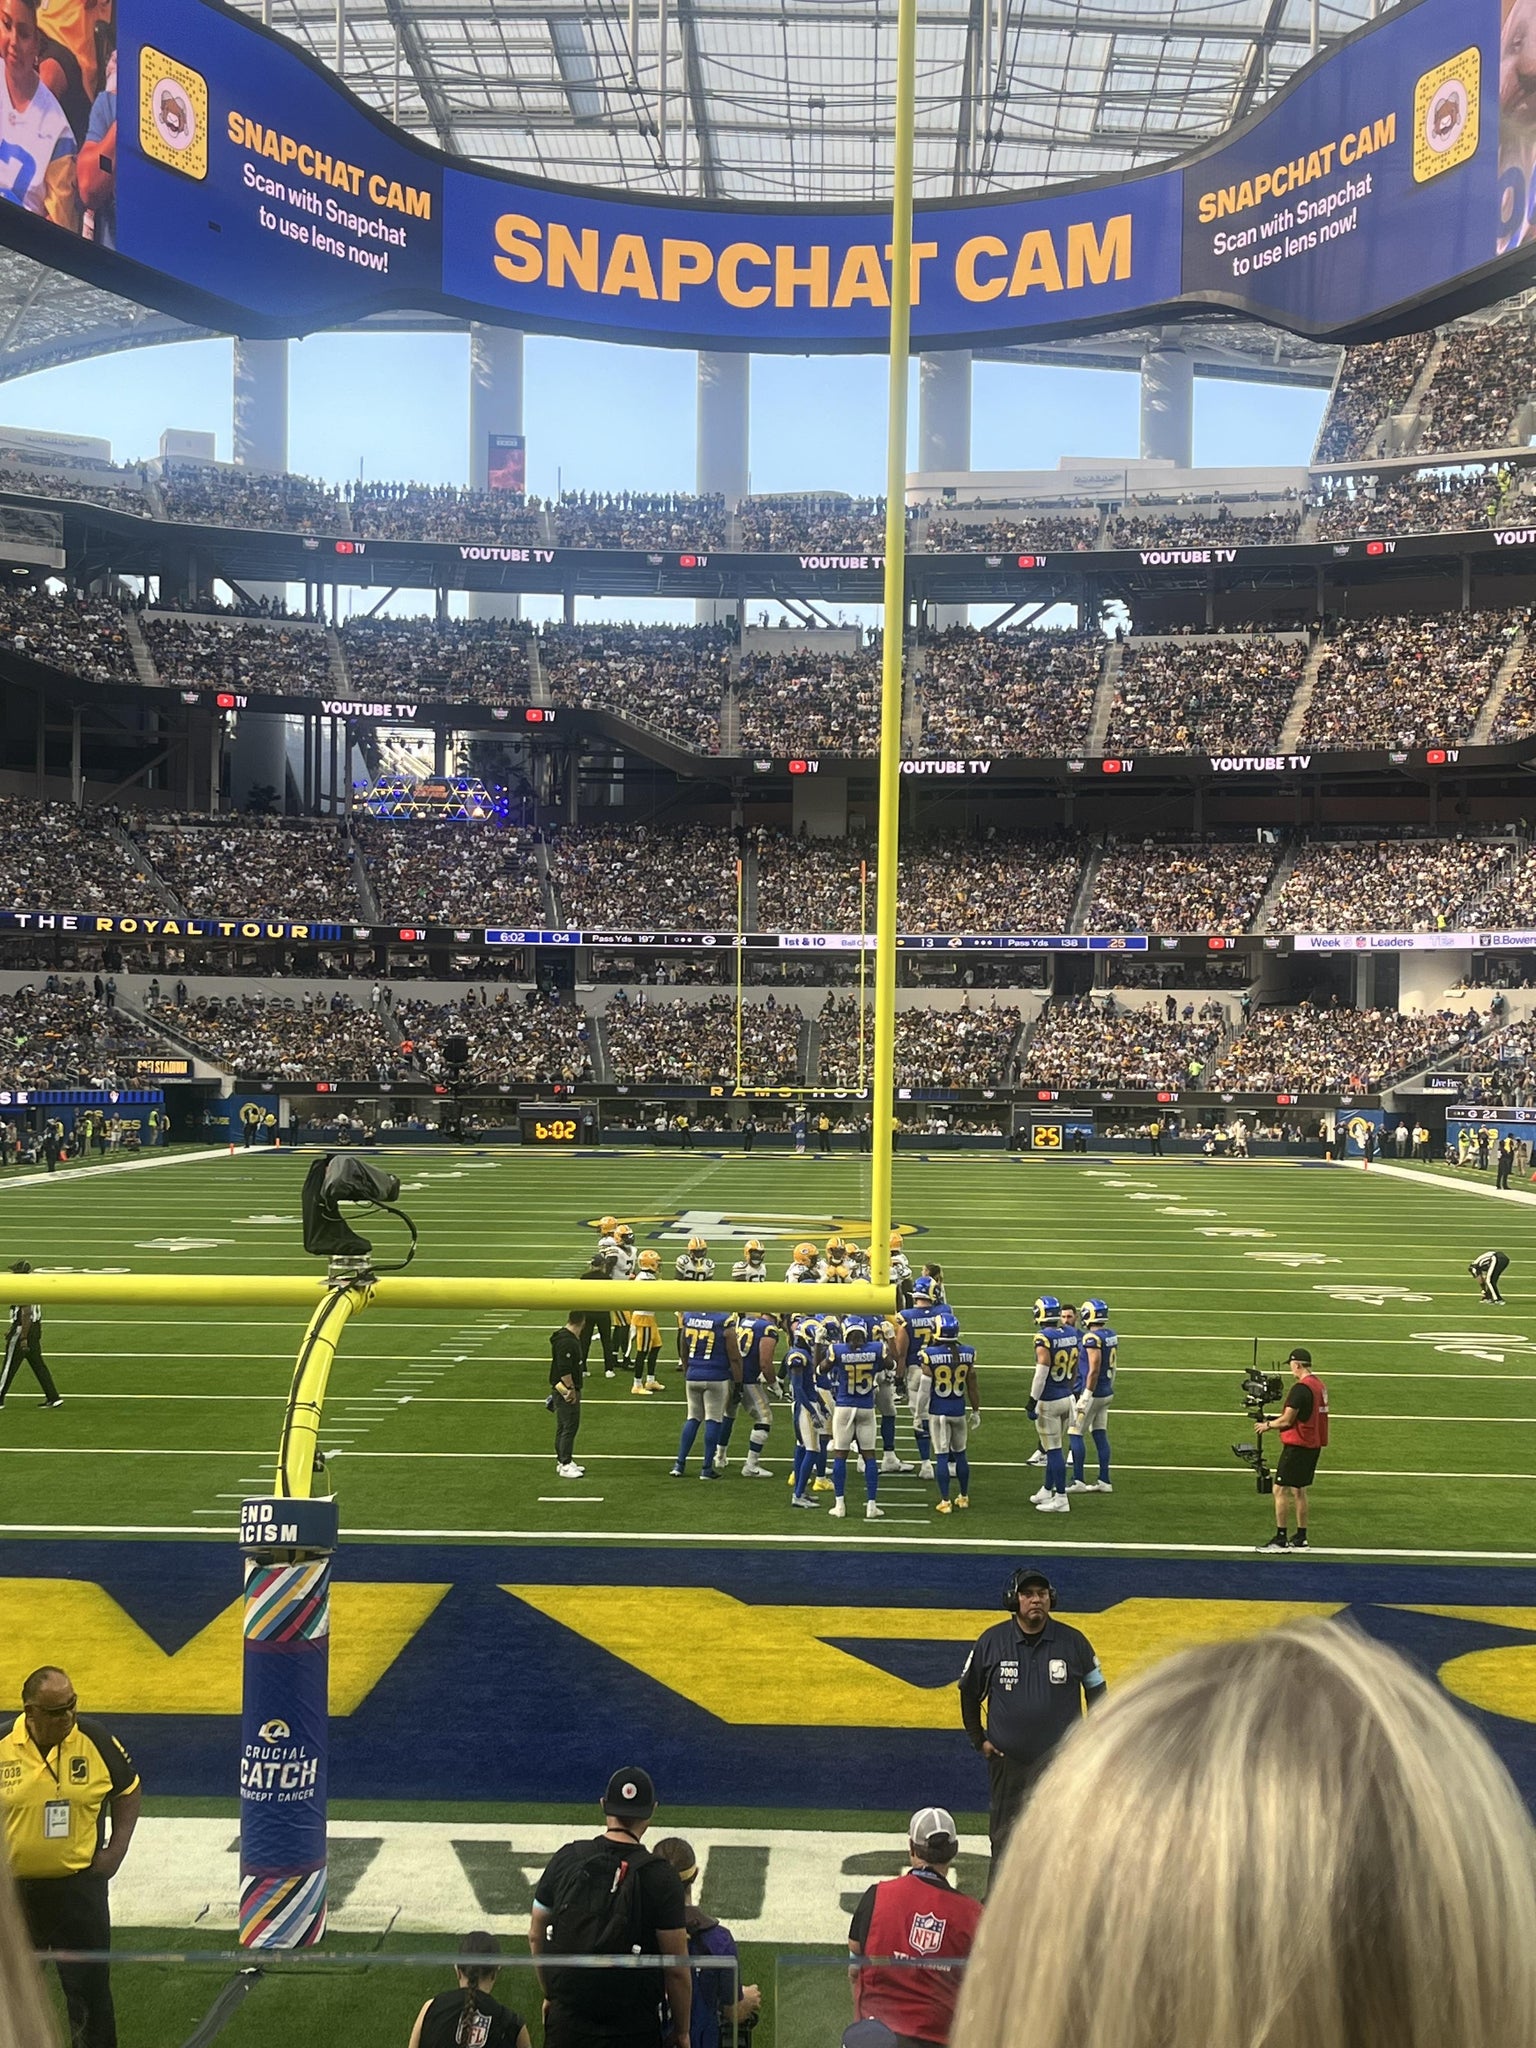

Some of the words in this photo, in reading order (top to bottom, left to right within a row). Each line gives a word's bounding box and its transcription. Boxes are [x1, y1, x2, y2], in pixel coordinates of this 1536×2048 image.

[228, 111, 365, 196] SNAPCHAT
[368, 174, 431, 220] CAM
[1198, 142, 1336, 224] SNAPCHAT
[1339, 112, 1396, 166] CAM
[243, 162, 285, 201] Scan
[288, 188, 323, 217] with
[325, 198, 407, 248] Snapchat
[1213, 227, 1257, 256] Scan
[1260, 208, 1294, 240] with
[1296, 172, 1373, 225] Snapchat
[259, 205, 277, 231] to
[279, 217, 309, 244] use
[311, 225, 346, 259] lens
[348, 245, 389, 274] now!
[1232, 256, 1250, 277] to
[1252, 245, 1282, 271] use
[1284, 230, 1317, 258] lens
[1319, 206, 1358, 244] now!
[494, 214, 938, 308] SNAPCHAT
[955, 215, 1132, 302] CAM
[354, 543, 366, 554] TV
[1384, 541, 1396, 553] TV
[459, 546, 530, 562] YOUTUBE
[533, 550, 555, 563] TV
[1035, 556, 1047, 567] TV
[1139, 551, 1212, 565] YOUTUBE
[1215, 549, 1237, 563] TV
[696, 556, 708, 568] TV
[799, 556, 869, 569] YOUTUBE
[871, 556, 887, 569] T
[235, 695, 248, 708] TV
[321, 700, 393, 717] YOUTUBE
[396, 704, 418, 718] TV
[544, 709, 556, 722] TV
[1446, 749, 1459, 762] TV
[807, 760, 819, 773] TV
[968, 760, 991, 774] TV
[1121, 760, 1134, 773] TV
[1210, 757, 1284, 772] YOUTUBE
[1287, 755, 1311, 770] TV
[14, 913, 78, 930] THE
[96, 917, 203, 936] ROYAL
[219, 922, 310, 939] TOUR
[415, 929, 426, 941] TV
[500, 932, 526, 943] 6:02
[592, 934, 614, 944] Pass
[615, 934, 633, 944] Yds
[638, 935, 656, 944] 197
[731, 936, 748, 946] 24
[784, 937, 800, 946] 1st
[801, 937, 810, 946] &
[812, 937, 826, 947] 10
[1310, 937, 1341, 948] Week
[1370, 936, 1415, 948] Leaders
[921, 937, 934, 948] 13
[1007, 938, 1031, 948] Pass
[1031, 938, 1050, 948] Yds
[1061, 938, 1079, 947] 138
[1225, 937, 1236, 949] TV
[154, 1060, 188, 1074] STADIUM
[566, 1085, 576, 1094] TV
[812, 1087, 913, 1100] HOUE
[1050, 1091, 1060, 1100] TV
[1169, 1092, 1179, 1102] TV
[1290, 1095, 1299, 1105] TV
[1482, 1110, 1498, 1120] 24
[535, 1120, 577, 1139] 6:02
[1034, 1126, 1060, 1147] 25
[685, 1327, 715, 1360] 77
[844, 1363, 874, 1396] 15
[934, 1364, 969, 1398] 88
[241, 1504, 274, 1524] END
[1000, 1667, 1019, 1678] 7000
[245, 1744, 307, 1760] CRUCIAL
[240, 1757, 319, 1790] CATCH
[277, 1788, 315, 1803] CANCER
[914, 1928, 938, 1950] NFL
